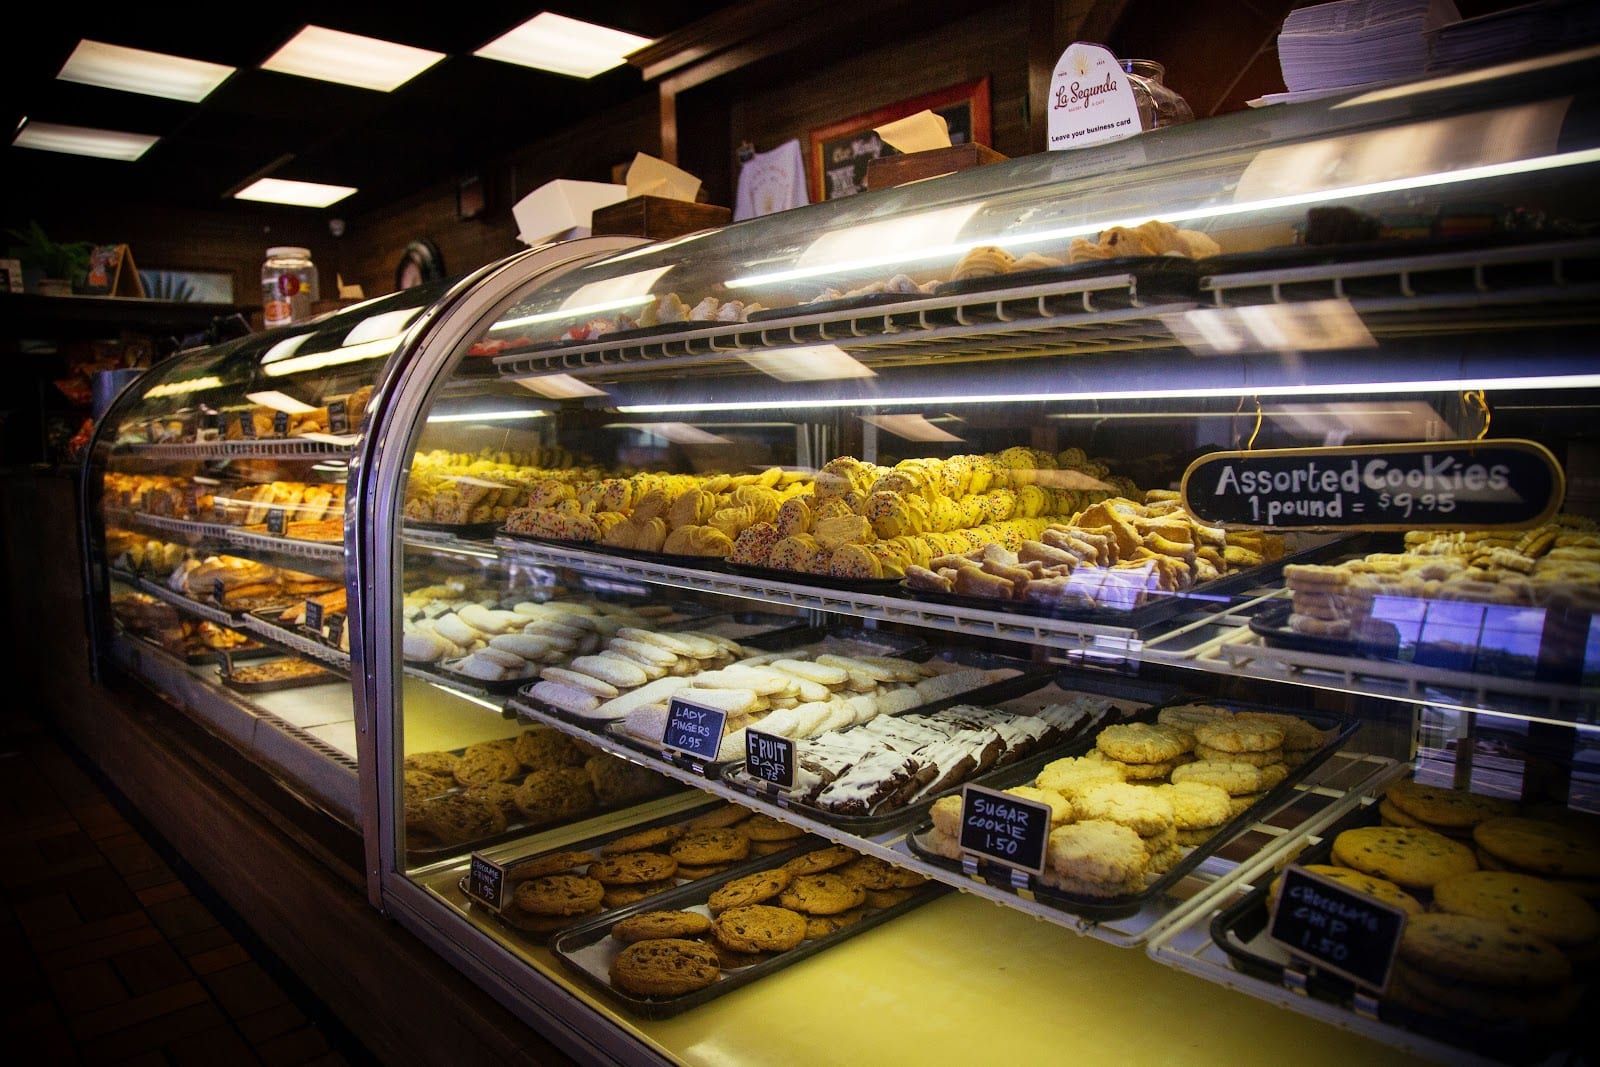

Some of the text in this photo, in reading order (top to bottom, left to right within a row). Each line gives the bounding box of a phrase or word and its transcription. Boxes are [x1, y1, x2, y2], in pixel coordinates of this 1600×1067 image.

[1054, 72, 1117, 109] La Segunda
[1051, 117, 1131, 142] Leave your business card
[1216, 460, 1360, 495] Assorted
[1248, 496, 1259, 521] 1
[1268, 495, 1342, 524] pound
[1378, 492, 1457, 518] $9.95
[671, 719, 710, 737] FINGERS
[675, 707, 706, 724] LADY
[679, 735, 702, 748] 0.95
[748, 733, 787, 763] FRUIT
[751, 756, 785, 775] BAR
[974, 799, 1029, 826] SUGAR
[986, 834, 1018, 854] 1.50
[1301, 930, 1348, 960] 1.50
